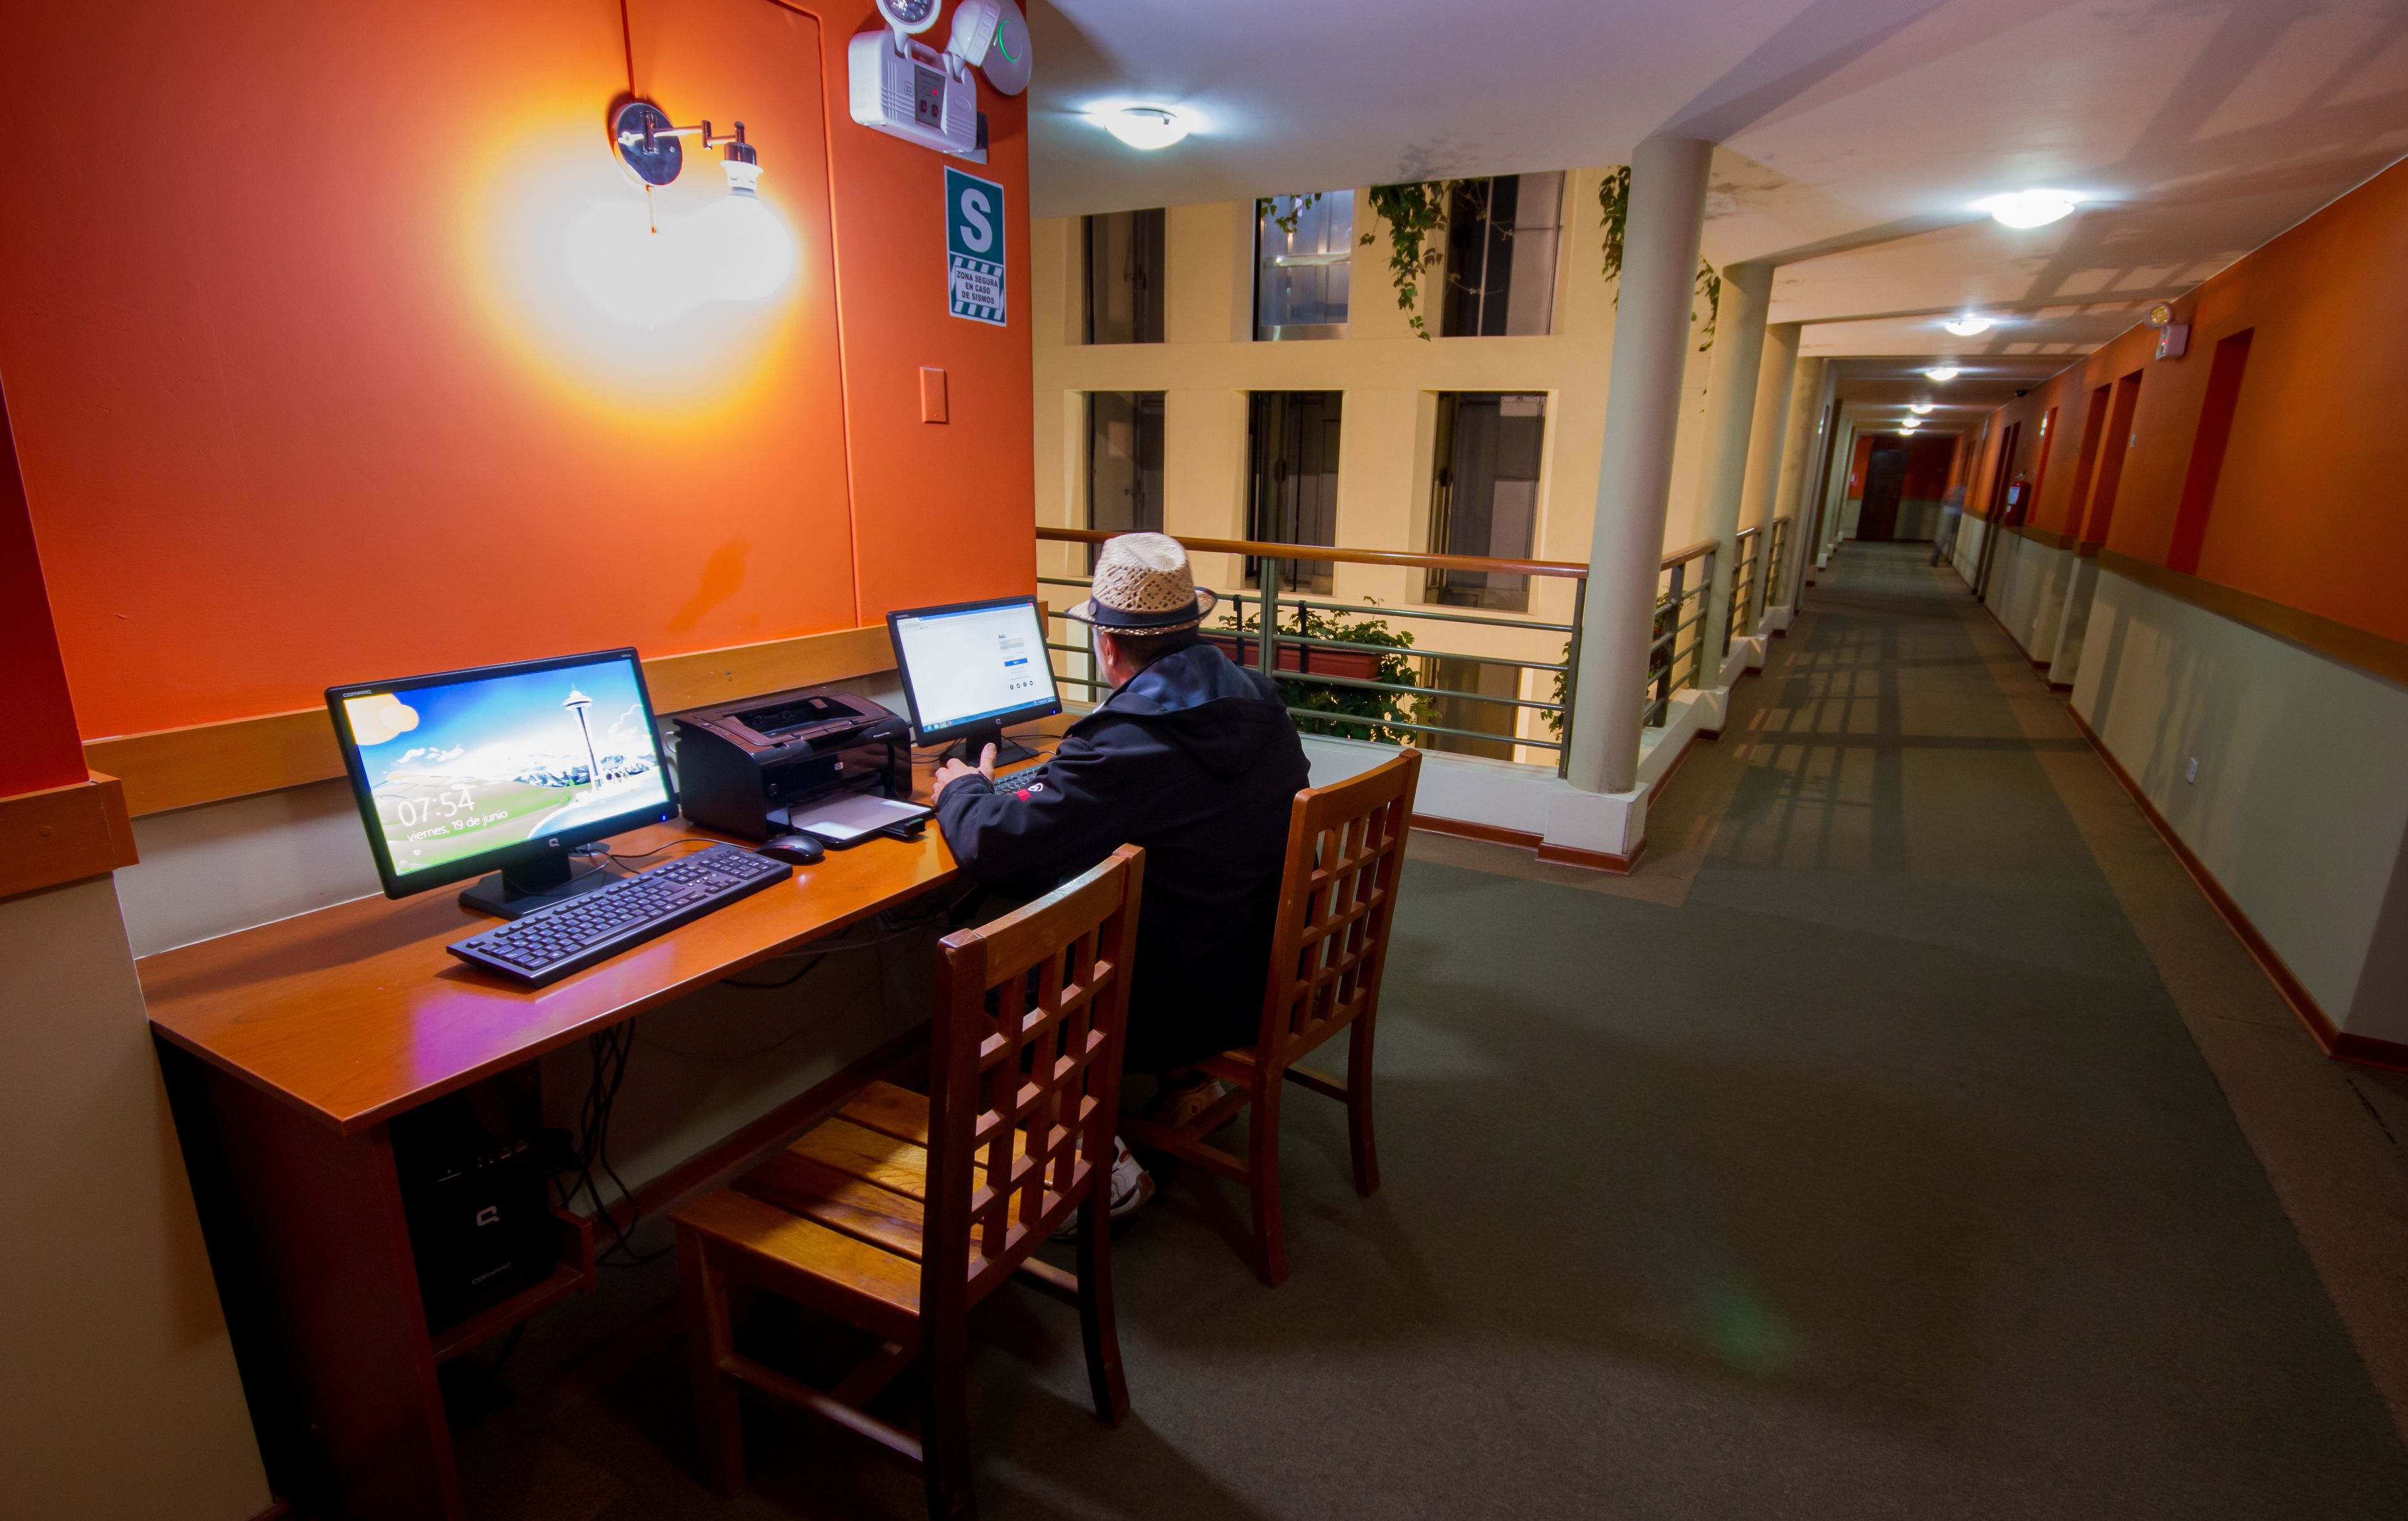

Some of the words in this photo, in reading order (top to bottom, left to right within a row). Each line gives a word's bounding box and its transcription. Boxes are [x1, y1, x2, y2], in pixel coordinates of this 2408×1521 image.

[960, 188, 993, 252] S
[957, 270, 973, 282] ZONA
[974, 275, 998, 287] SEGURA
[965, 282, 973, 290] EN
[975, 285, 991, 294] CASO
[961, 290, 970, 299] DE
[971, 293, 995, 304] SISMOS
[398, 785, 475, 827] 07:54
[407, 825, 450, 842] viernes,
[452, 819, 463, 831] 19
[466, 815, 480, 827] de
[482, 810, 508, 827] junio
